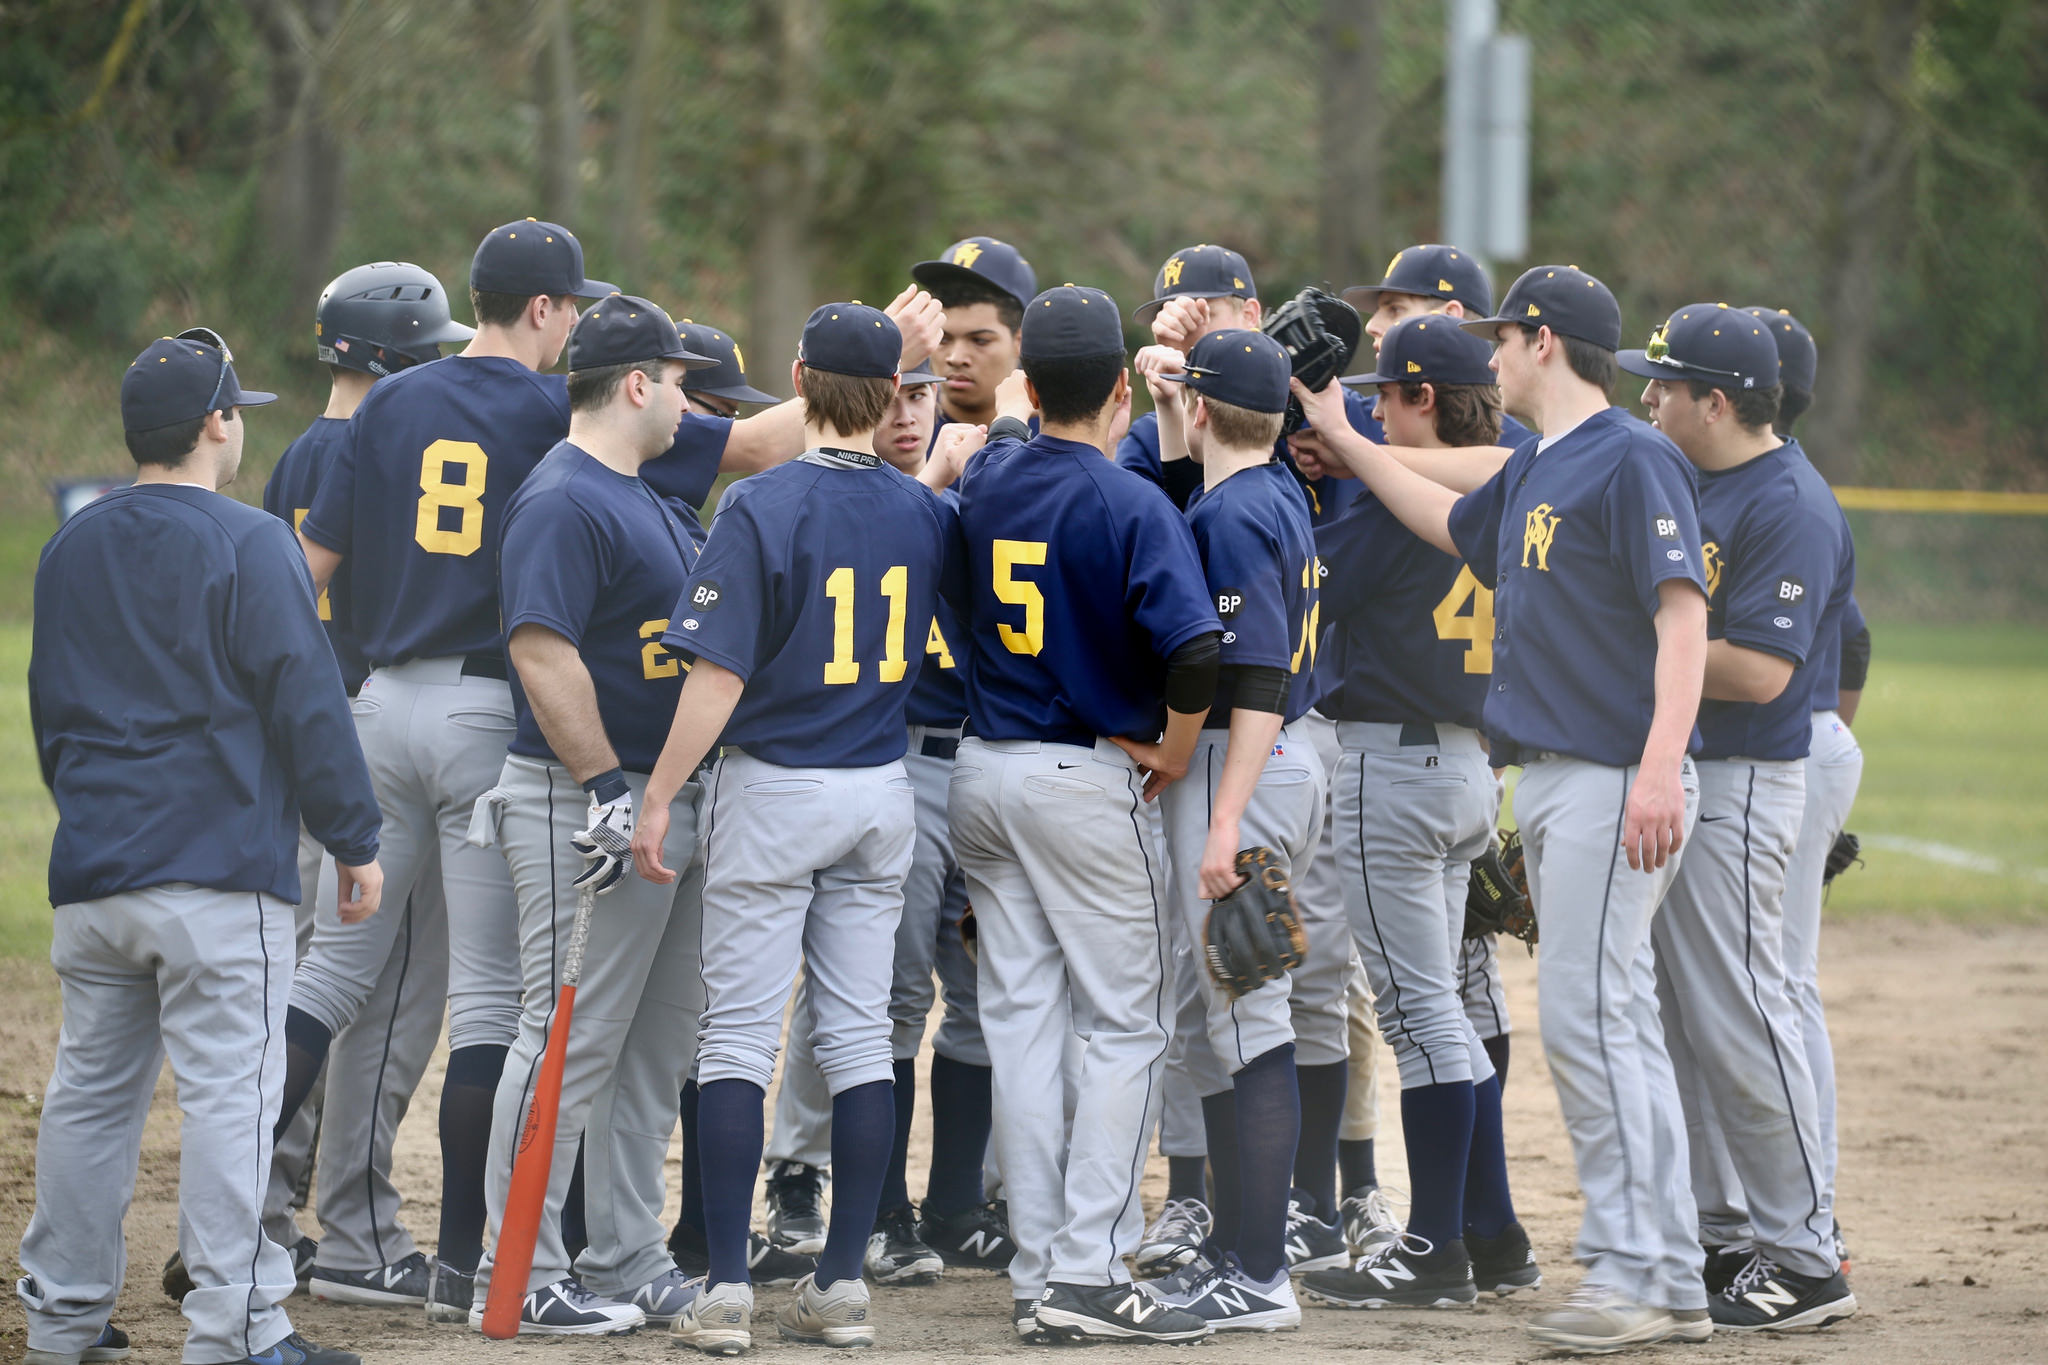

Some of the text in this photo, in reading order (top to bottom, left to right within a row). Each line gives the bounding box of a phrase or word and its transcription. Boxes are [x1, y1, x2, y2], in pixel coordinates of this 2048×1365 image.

[837, 451, 860, 463] NIKE
[414, 438, 489, 557] 8
[1656, 518, 1678, 536] BP
[693, 586, 719, 606] BP
[992, 539, 1048, 658] 5
[1779, 581, 1804, 601] BP
[1219, 595, 1242, 613] BP
[823, 565, 908, 685] 11
